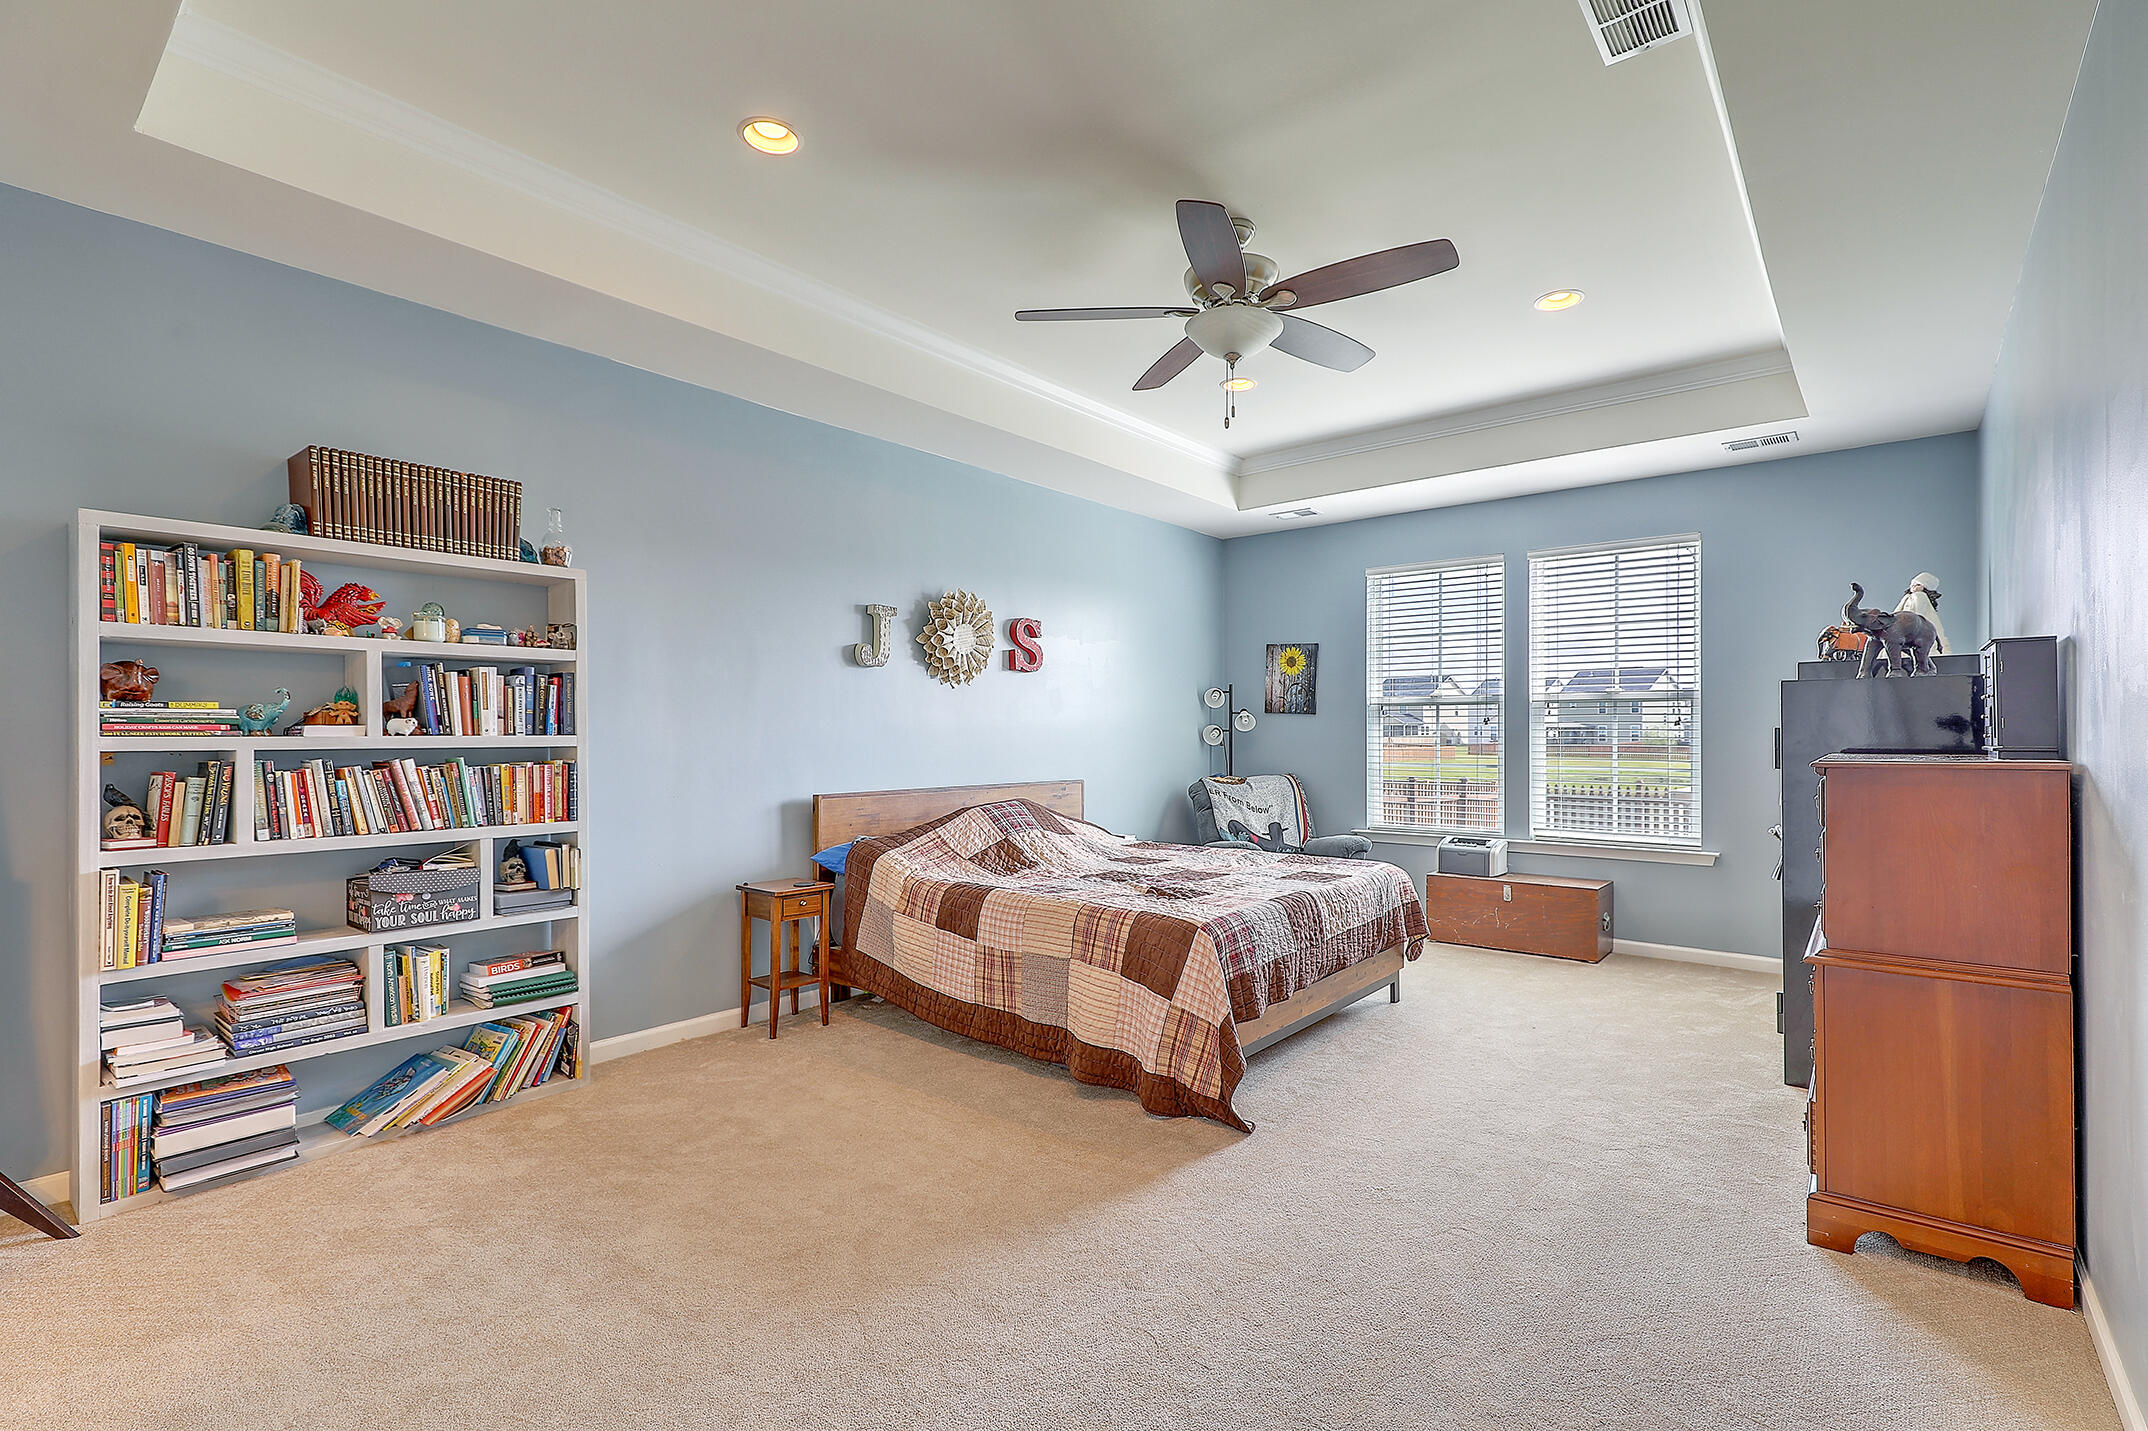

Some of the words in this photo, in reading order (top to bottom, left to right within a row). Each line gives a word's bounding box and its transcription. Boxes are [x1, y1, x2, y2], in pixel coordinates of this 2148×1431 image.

[188, 555, 197, 571] DOWN
[188, 572, 198, 600] TOGETHER
[854, 603, 898, 668] J
[1008, 617, 1044, 672] S
[428, 683, 436, 701] ROWE
[163, 774, 174, 799] AESOP'S
[1222, 791, 1244, 806] From
[160, 800, 171, 822] FABLES
[123, 895, 132, 917] Complete
[371, 900, 396, 917] take
[398, 901, 421, 912] time
[440, 903, 475, 921] happy
[106, 913, 114, 929] Anything
[374, 914, 406, 929] YOUR
[411, 910, 439, 925] SOUL
[231, 936, 253, 944] NORM
[122, 948, 130, 965] Manual
[386, 961, 394, 977] North
[491, 962, 520, 975] BIRDS
[388, 978, 396, 1003] American
